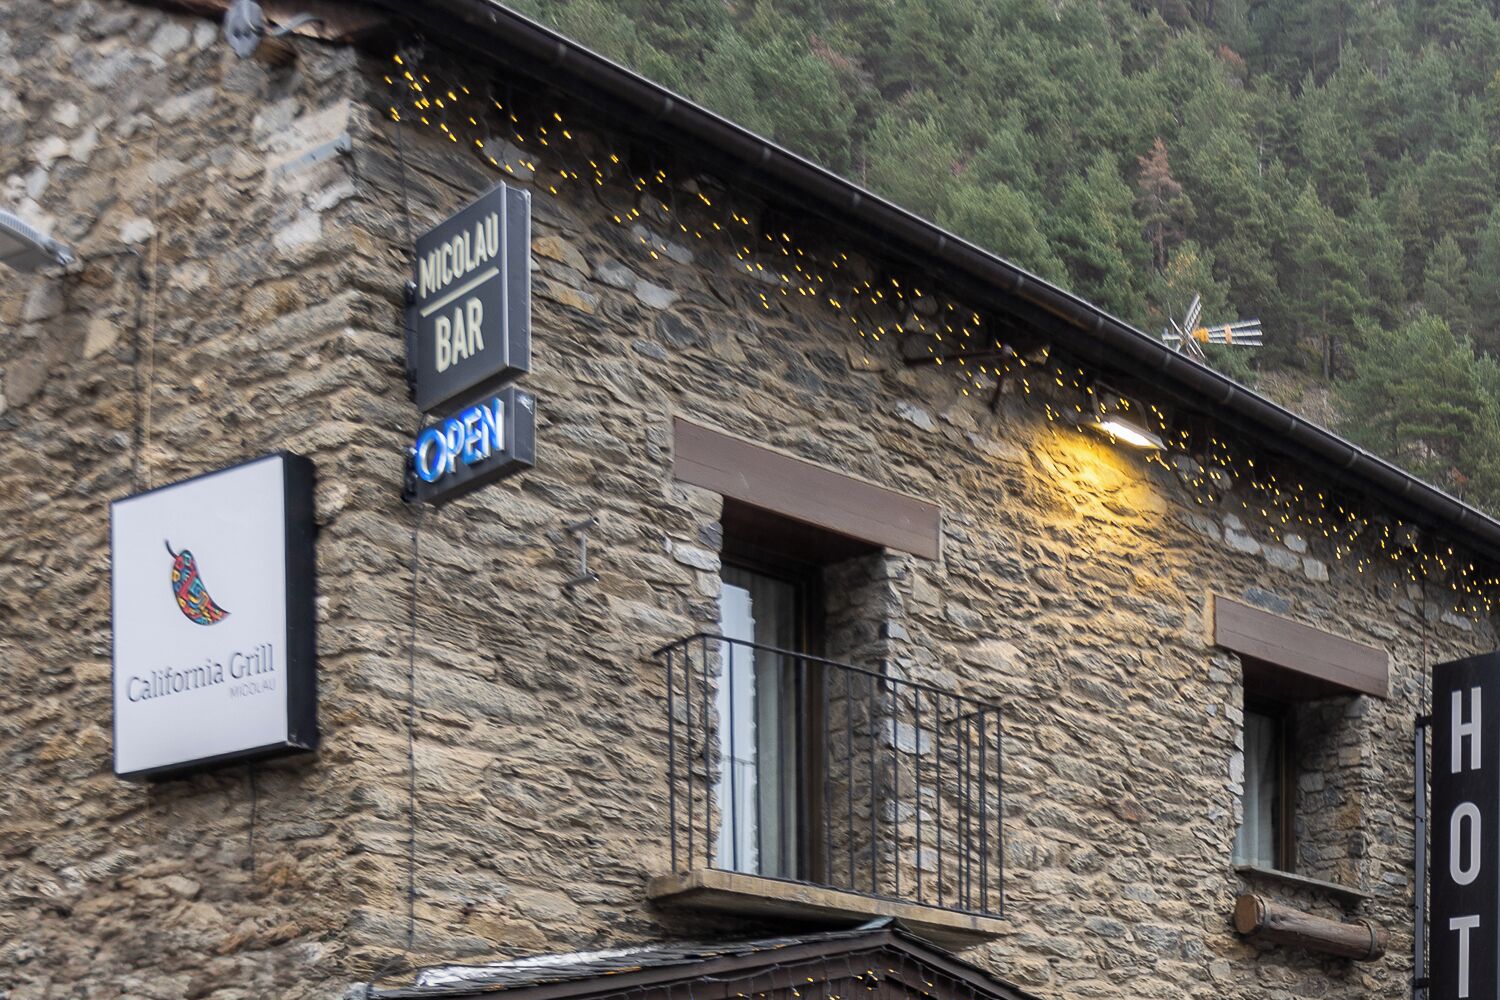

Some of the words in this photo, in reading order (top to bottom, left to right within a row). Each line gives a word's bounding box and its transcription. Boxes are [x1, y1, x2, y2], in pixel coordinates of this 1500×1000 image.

[419, 211, 499, 299] MICOLAU
[435, 297, 484, 373] BAR
[415, 397, 505, 482] OPEN
[128, 659, 224, 702] California
[230, 643, 275, 679] Grill
[230, 678, 276, 698] MICOLAU
